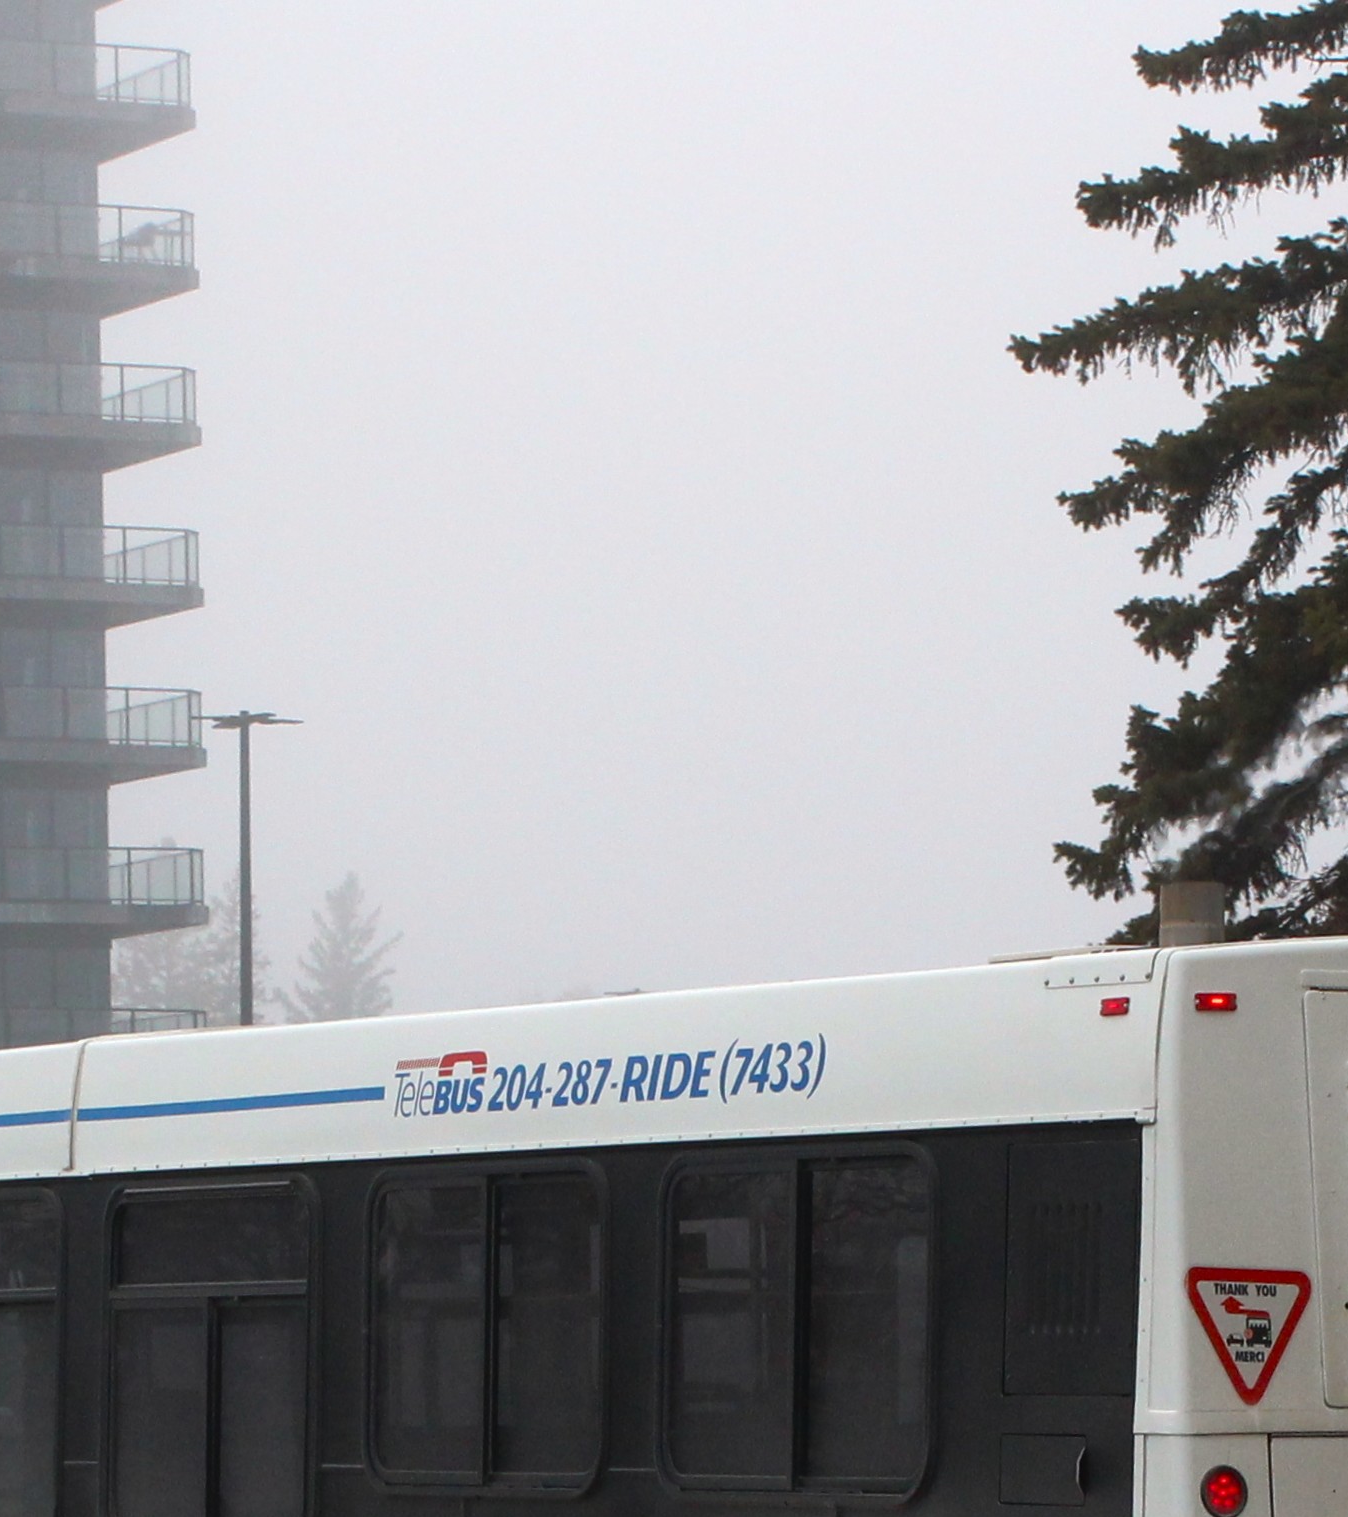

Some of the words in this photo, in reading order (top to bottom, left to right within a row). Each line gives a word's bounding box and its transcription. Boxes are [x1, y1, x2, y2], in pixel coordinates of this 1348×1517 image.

[393, 1071, 485, 1118] TeleBUS
[487, 1050, 716, 1113] 204-287-RIDE
[720, 1033, 827, 1104] (7433)
[1214, 1282, 1249, 1296] THANK
[1255, 1284, 1277, 1297] YOU
[1235, 1350, 1265, 1363] MERCI
